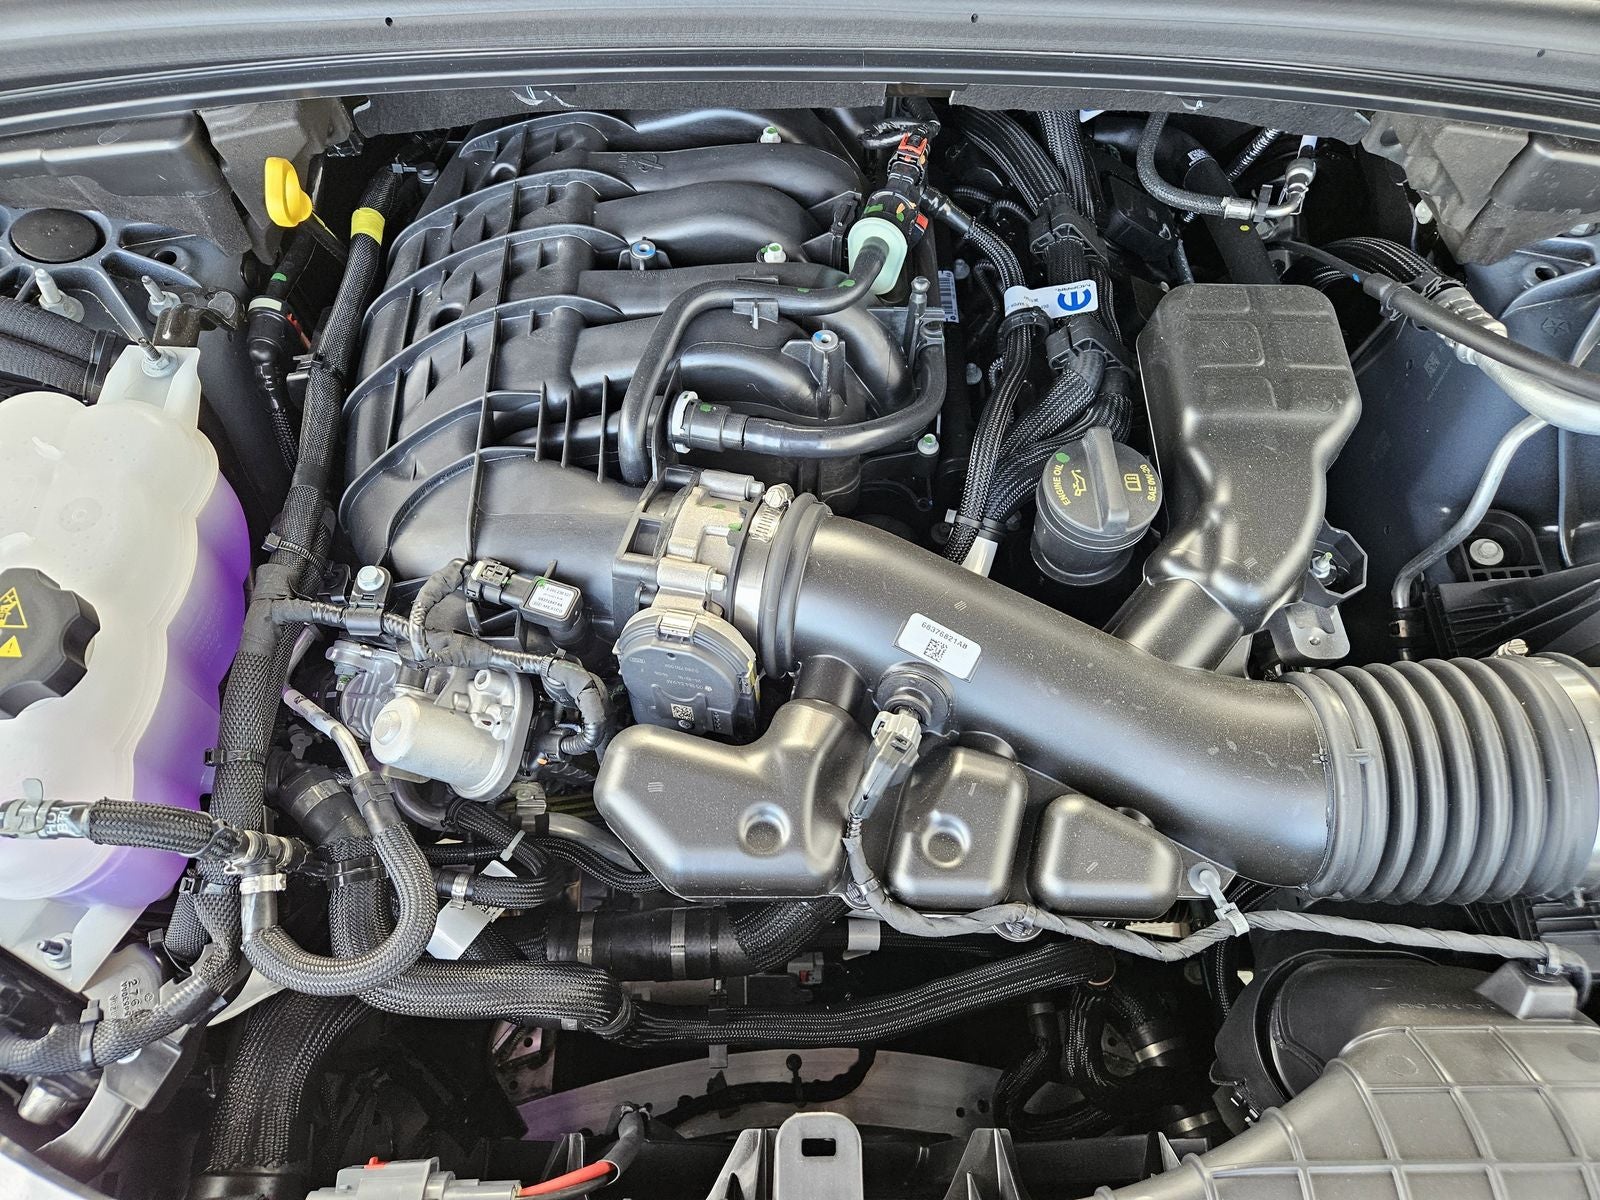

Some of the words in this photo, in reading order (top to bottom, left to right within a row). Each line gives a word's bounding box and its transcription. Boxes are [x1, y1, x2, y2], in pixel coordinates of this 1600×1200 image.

[1053, 463, 1064, 476] OIL
[1053, 477, 1071, 506] ENGINE
[1147, 486, 1157, 502] SAE
